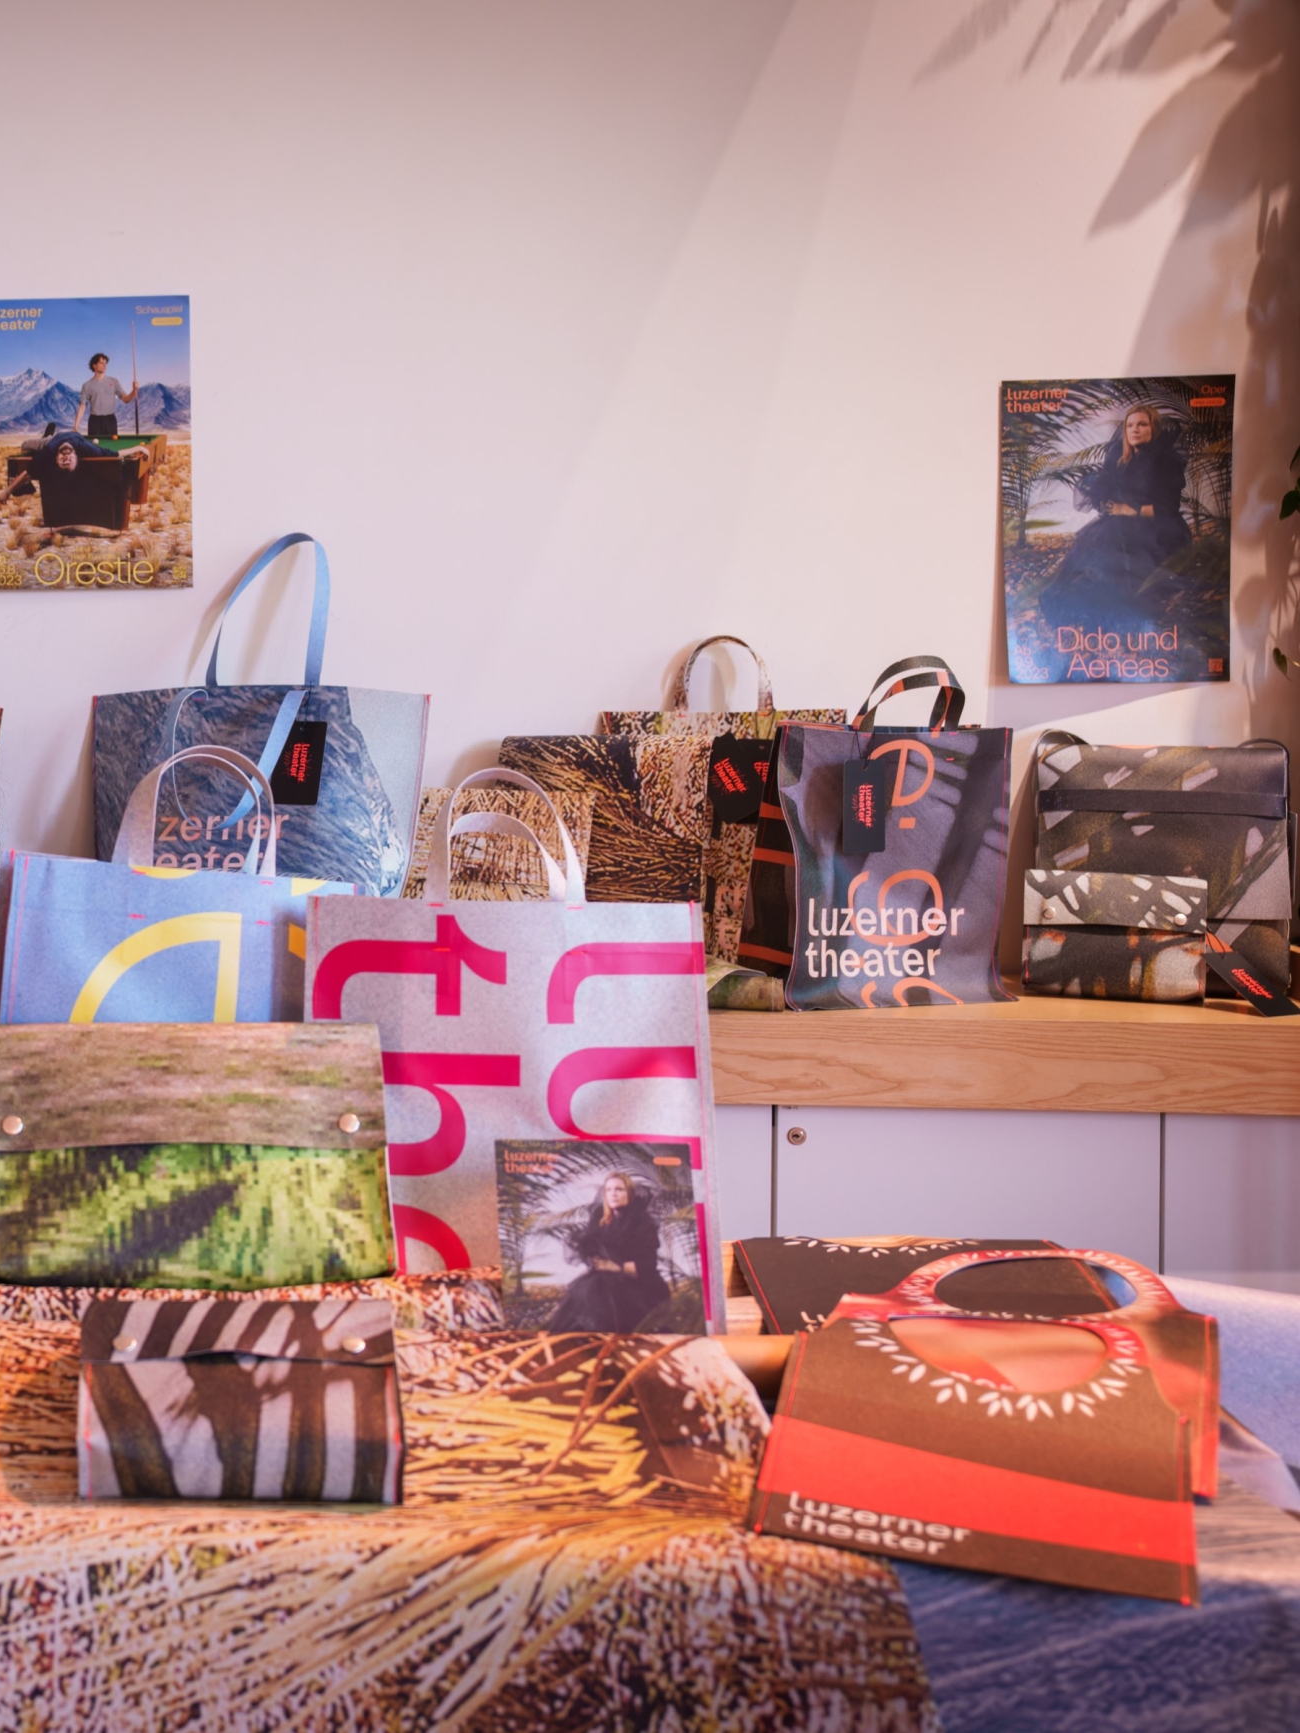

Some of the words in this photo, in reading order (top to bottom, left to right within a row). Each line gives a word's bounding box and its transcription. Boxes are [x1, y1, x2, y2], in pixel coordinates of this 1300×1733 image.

[1007, 387, 1068, 400] luzerner
[1201, 384, 1227, 395] Oper
[1006, 400, 1062, 413] theater
[34, 552, 154, 586] Orestie
[1057, 626, 1120, 653] Dido
[1127, 625, 1178, 650] und
[1016, 667, 1049, 680] 2023
[1066, 653, 1169, 679] Aeneas
[290, 743, 302, 777] theater
[297, 743, 310, 783] luzerner
[721, 758, 747, 792] luzerner
[713, 762, 737, 793] theater
[859, 785, 867, 823] theater
[865, 785, 874, 828] luzerner
[158, 813, 290, 842] zerner
[155, 846, 264, 870] eate
[807, 898, 965, 937] luzerner
[805, 940, 941, 978] theater
[504, 1161, 554, 1173] theater
[788, 1490, 971, 1542] luzerner
[782, 1511, 945, 1555] theater
